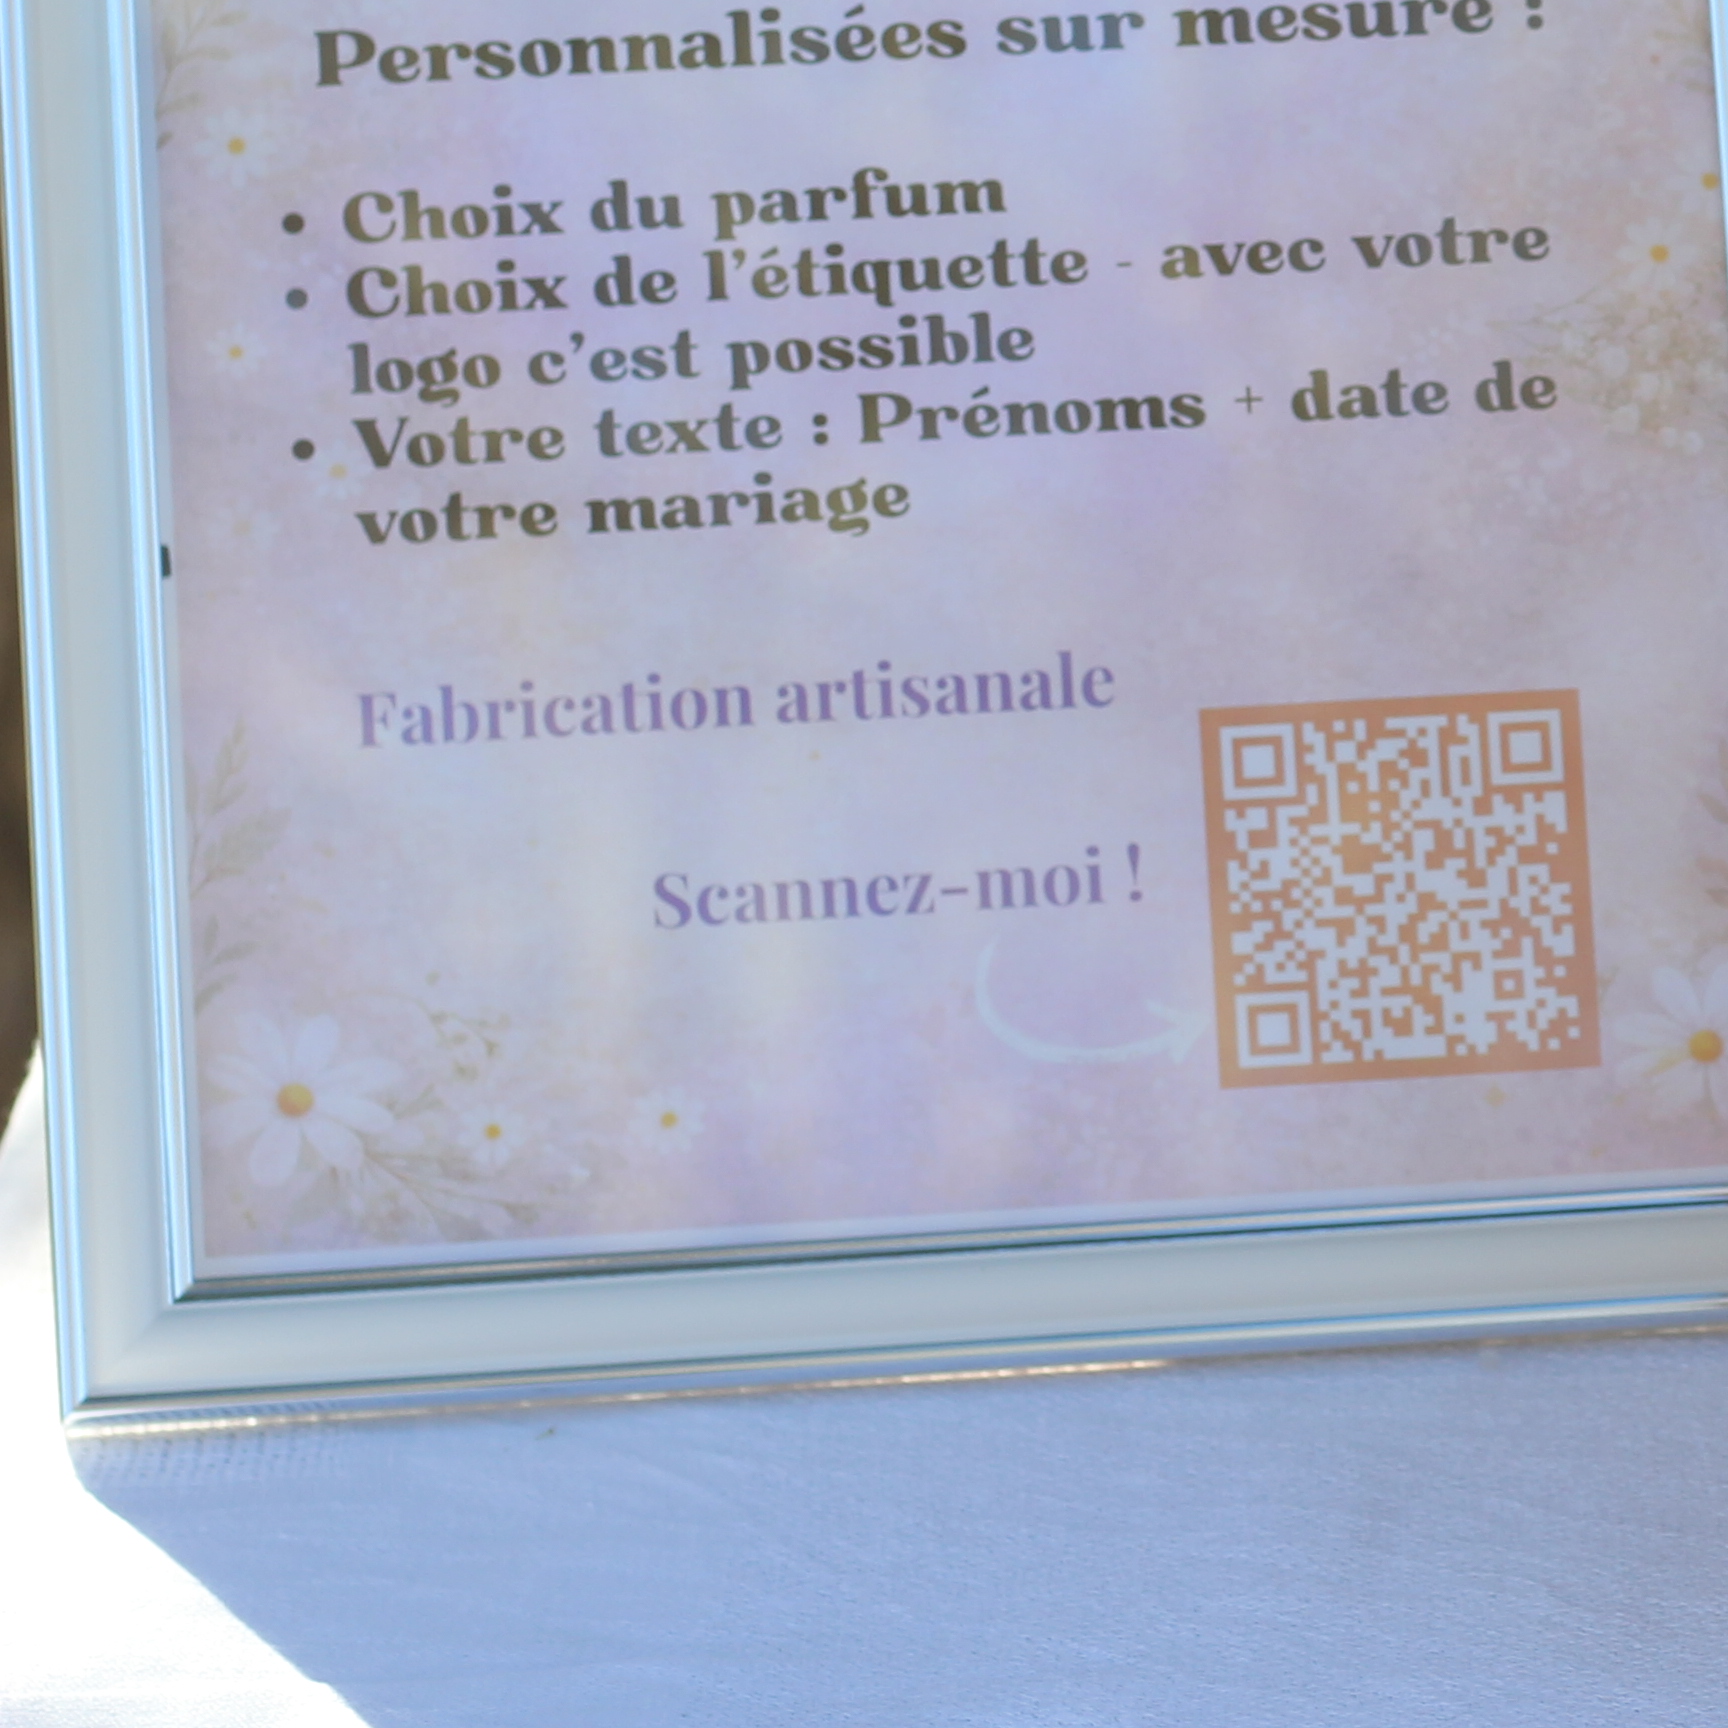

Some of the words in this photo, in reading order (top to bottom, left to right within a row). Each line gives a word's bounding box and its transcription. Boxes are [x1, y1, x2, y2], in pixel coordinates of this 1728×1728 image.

[312, 2, 968, 90] Personnalisées
[996, 0, 1146, 59] sur
[341, 183, 564, 246] Choix
[589, 179, 690, 235] du
[710, 165, 1006, 238] parfum
[344, 260, 570, 323] Choix
[592, 254, 680, 309] de
[1158, 223, 1327, 280] avec
[1351, 216, 1551, 272] votre
[347, 339, 502, 409] logo
[726, 311, 1036, 384] possible
[353, 412, 567, 473] Votre
[592, 400, 785, 461] texte
[810, 407, 831, 449] :
[858, 379, 1207, 446] Prénoms
[1233, 385, 1263, 415] +
[1288, 366, 1450, 424] date
[1472, 360, 1559, 415] de
[355, 486, 560, 542] votre
[585, 471, 911, 539] mariage
[355, 667, 757, 750] Fabrication
[773, 649, 1116, 725] artisanale
[652, 853, 1110, 931] Scannez-moi
[1125, 842, 1146, 905] !
